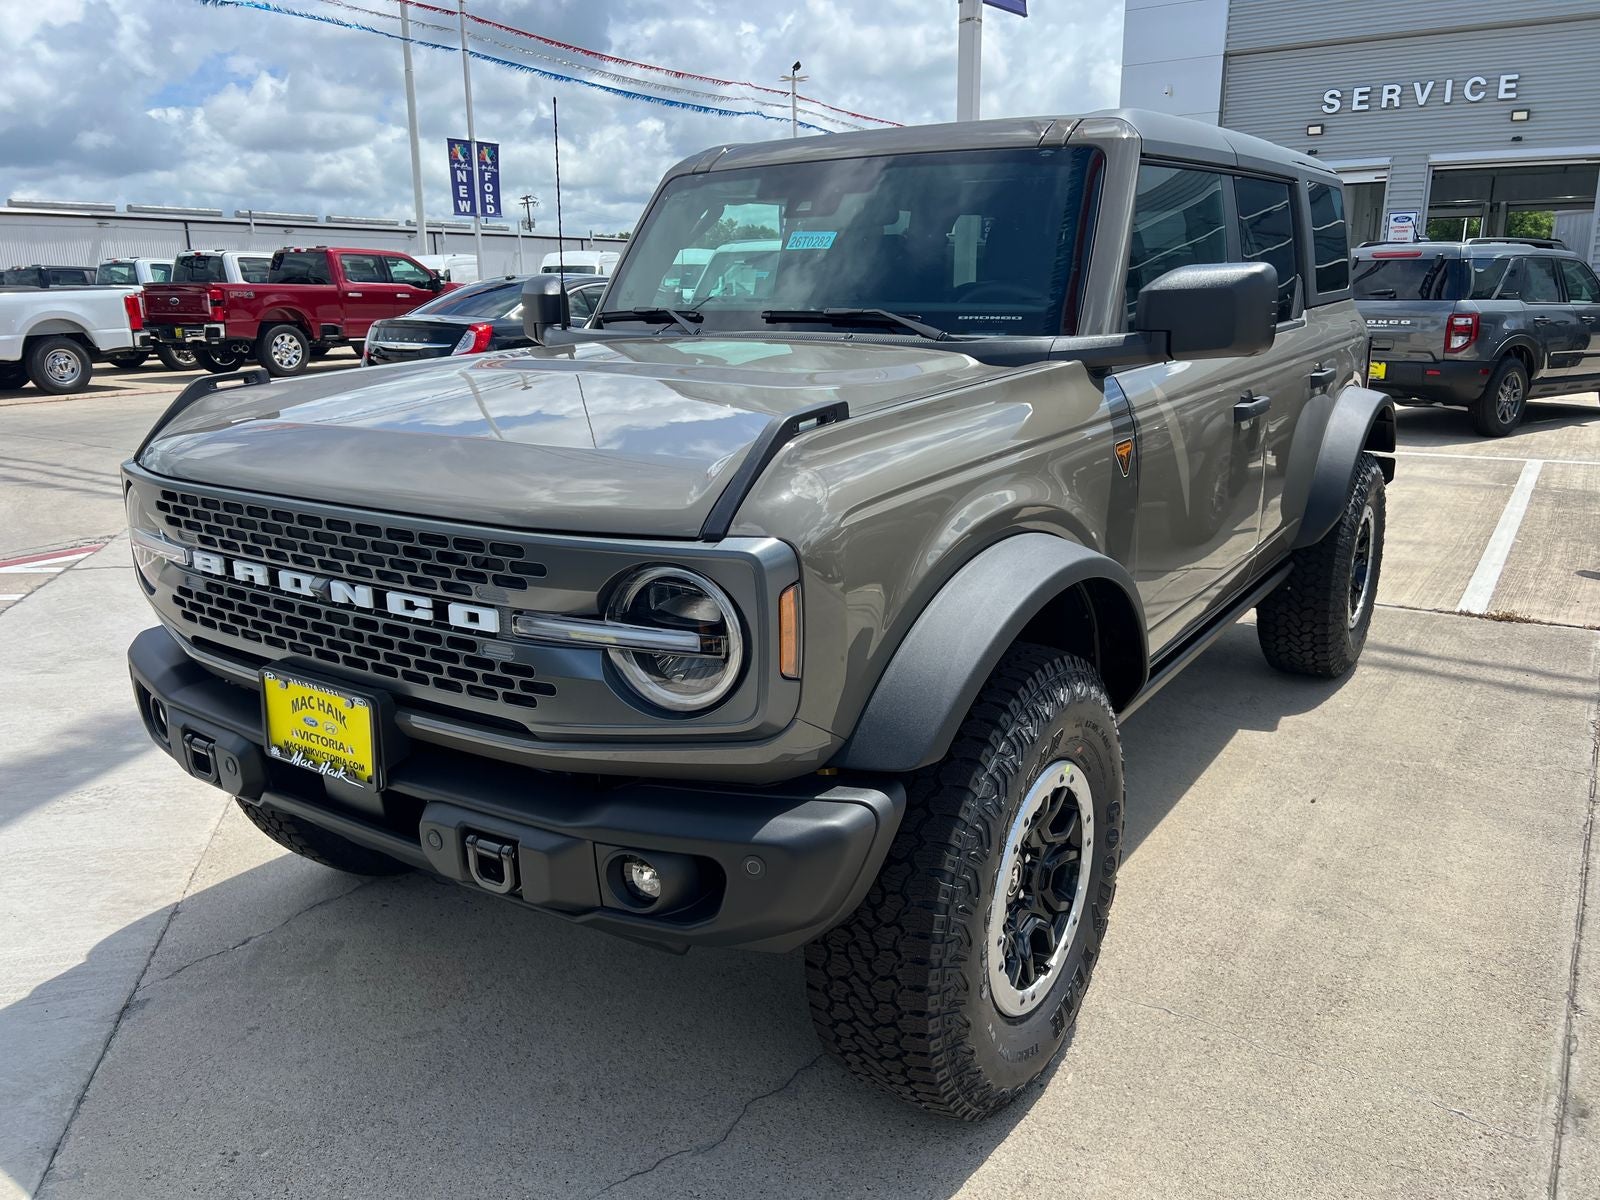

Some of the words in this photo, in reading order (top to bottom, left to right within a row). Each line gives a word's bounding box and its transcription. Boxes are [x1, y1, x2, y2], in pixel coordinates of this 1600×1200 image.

[1321, 74, 1520, 114] SERVICE
[456, 170, 471, 213] NEW
[484, 172, 495, 214] FORD
[789, 236, 831, 248] 26T0282
[193, 550, 500, 634] BRONCO
[291, 695, 315, 714] MAC
[316, 698, 347, 730] HAIK
[298, 729, 346, 753] VICTORIA
[290, 751, 316, 771] Mac
[318, 761, 354, 783] Haik
[1050, 800, 1121, 1041] GOODYEAR
